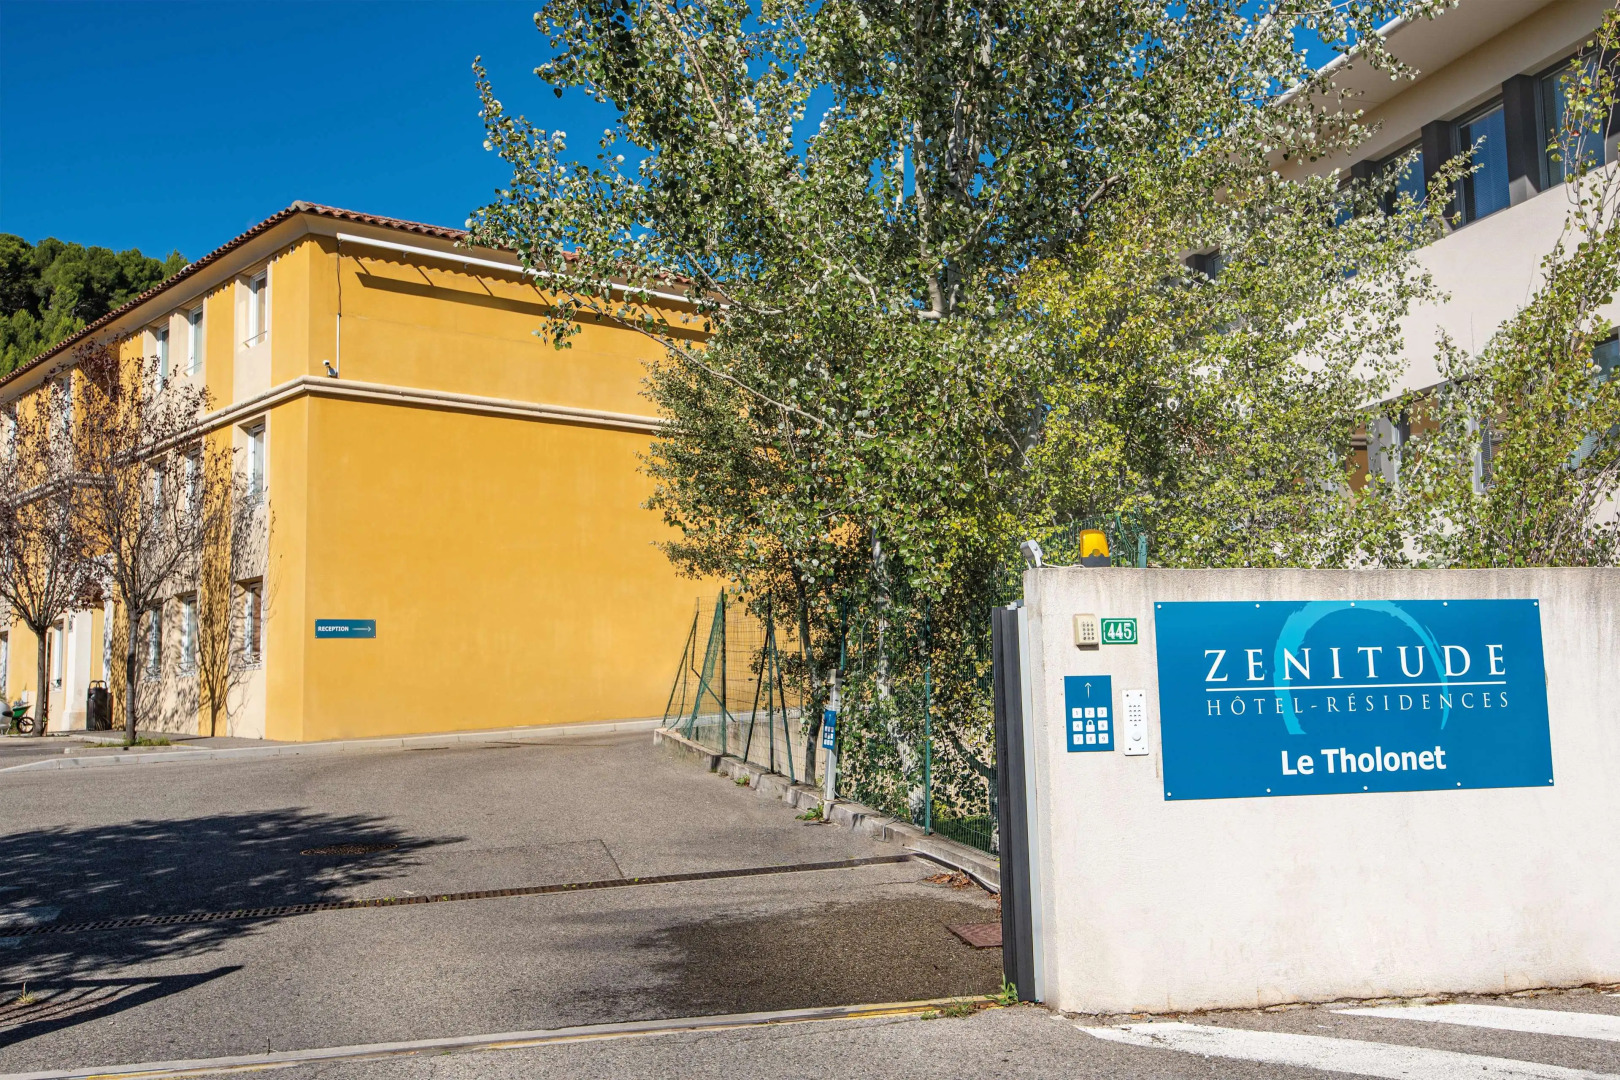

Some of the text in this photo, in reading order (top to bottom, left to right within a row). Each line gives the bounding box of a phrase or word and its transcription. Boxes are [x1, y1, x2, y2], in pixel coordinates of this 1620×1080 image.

[1107, 622, 1132, 640] 445
[1204, 644, 1507, 682] ZENITUDE
[1207, 691, 1509, 716] HÔTEL-RÉSIDENCES
[1281, 746, 1447, 775] Le Tholonet
